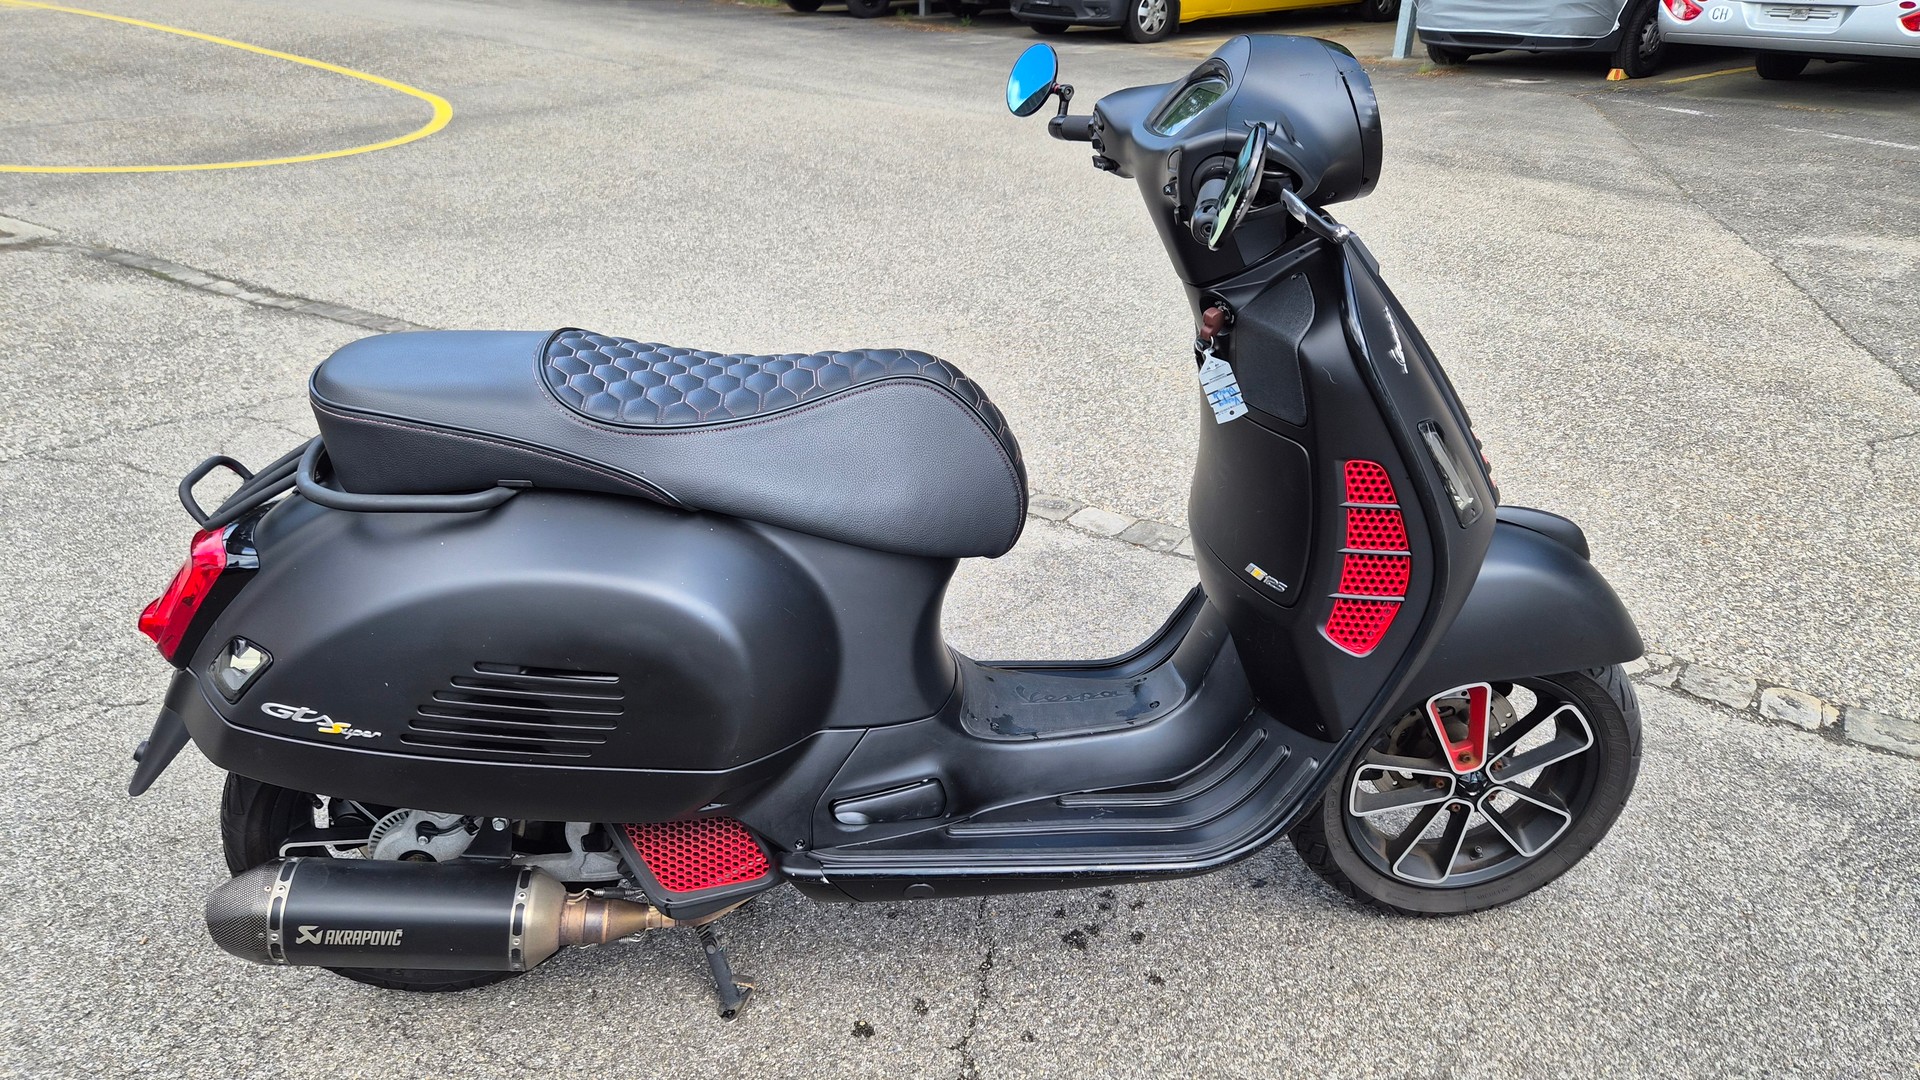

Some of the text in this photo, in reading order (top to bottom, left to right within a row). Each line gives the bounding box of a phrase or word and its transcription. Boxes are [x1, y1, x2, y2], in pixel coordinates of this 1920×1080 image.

[1711, 7, 1729, 21] CH
[1015, 682, 1128, 706] Vespa
[324, 928, 404, 946] AKRAPOVIČ
